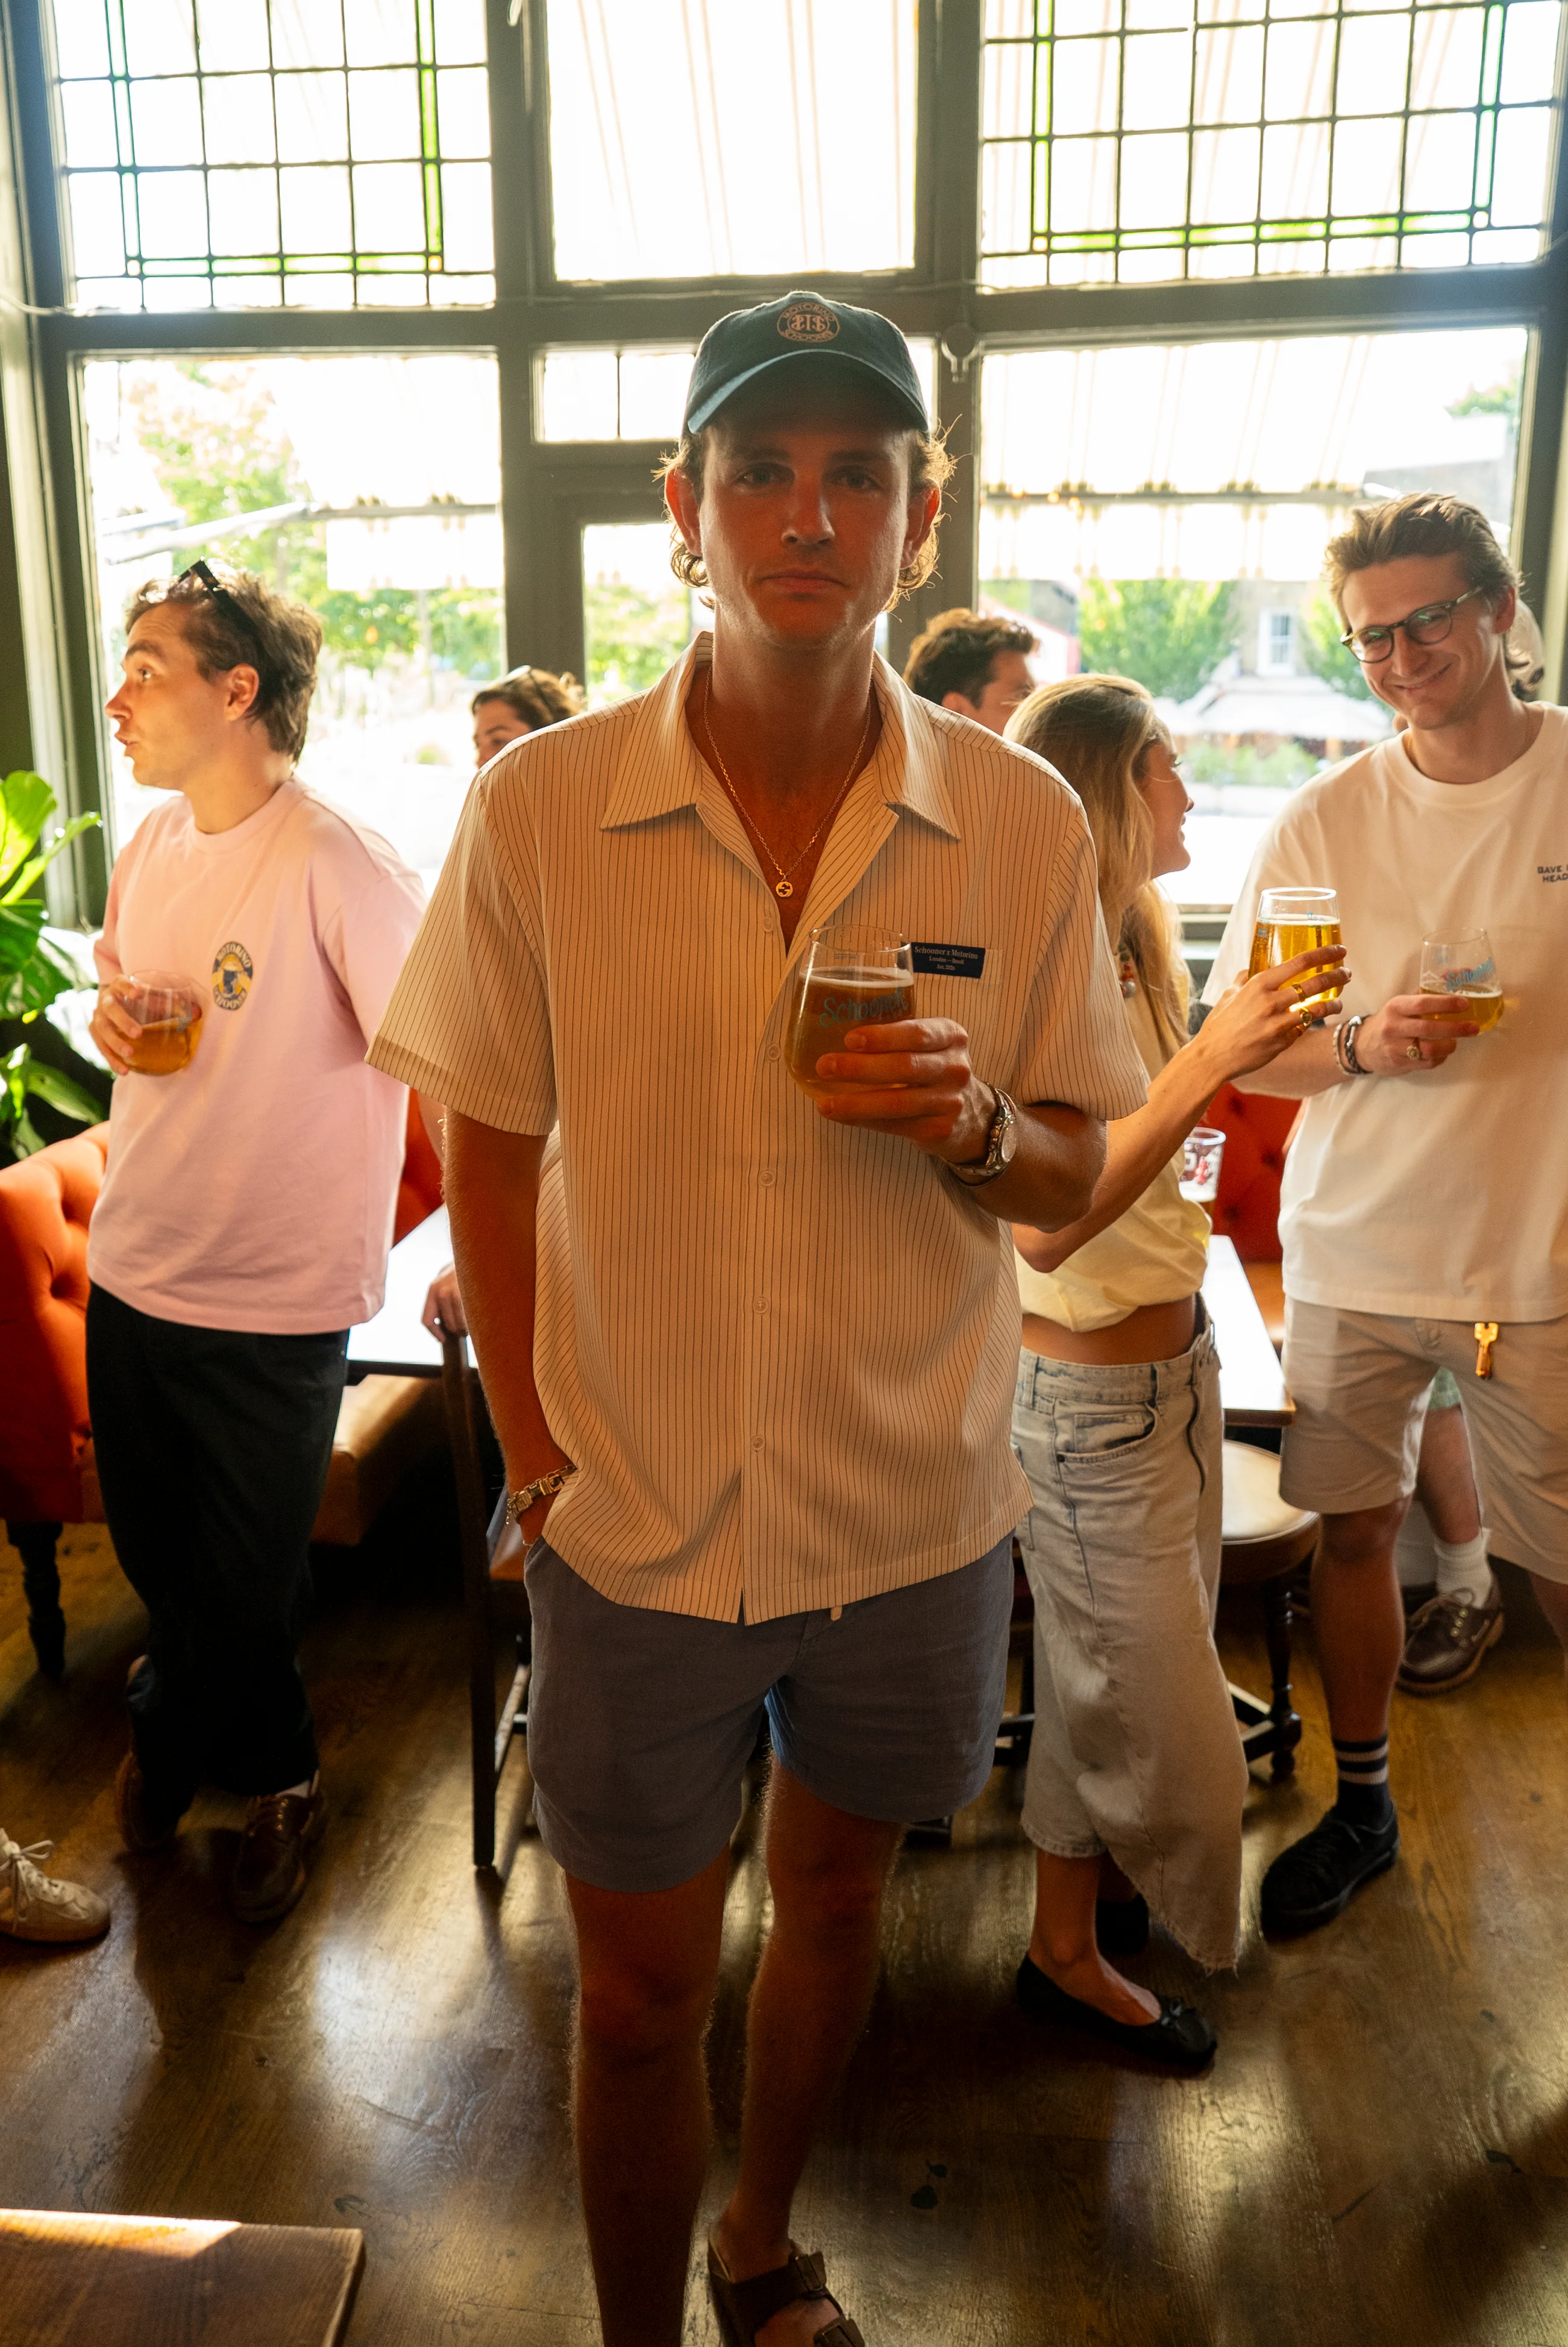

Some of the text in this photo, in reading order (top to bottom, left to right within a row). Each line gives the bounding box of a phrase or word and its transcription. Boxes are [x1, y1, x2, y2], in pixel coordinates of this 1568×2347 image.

[783, 304, 835, 321] MOTORINO
[915, 946, 946, 955] Schooner
[952, 949, 978, 959] Motorino
